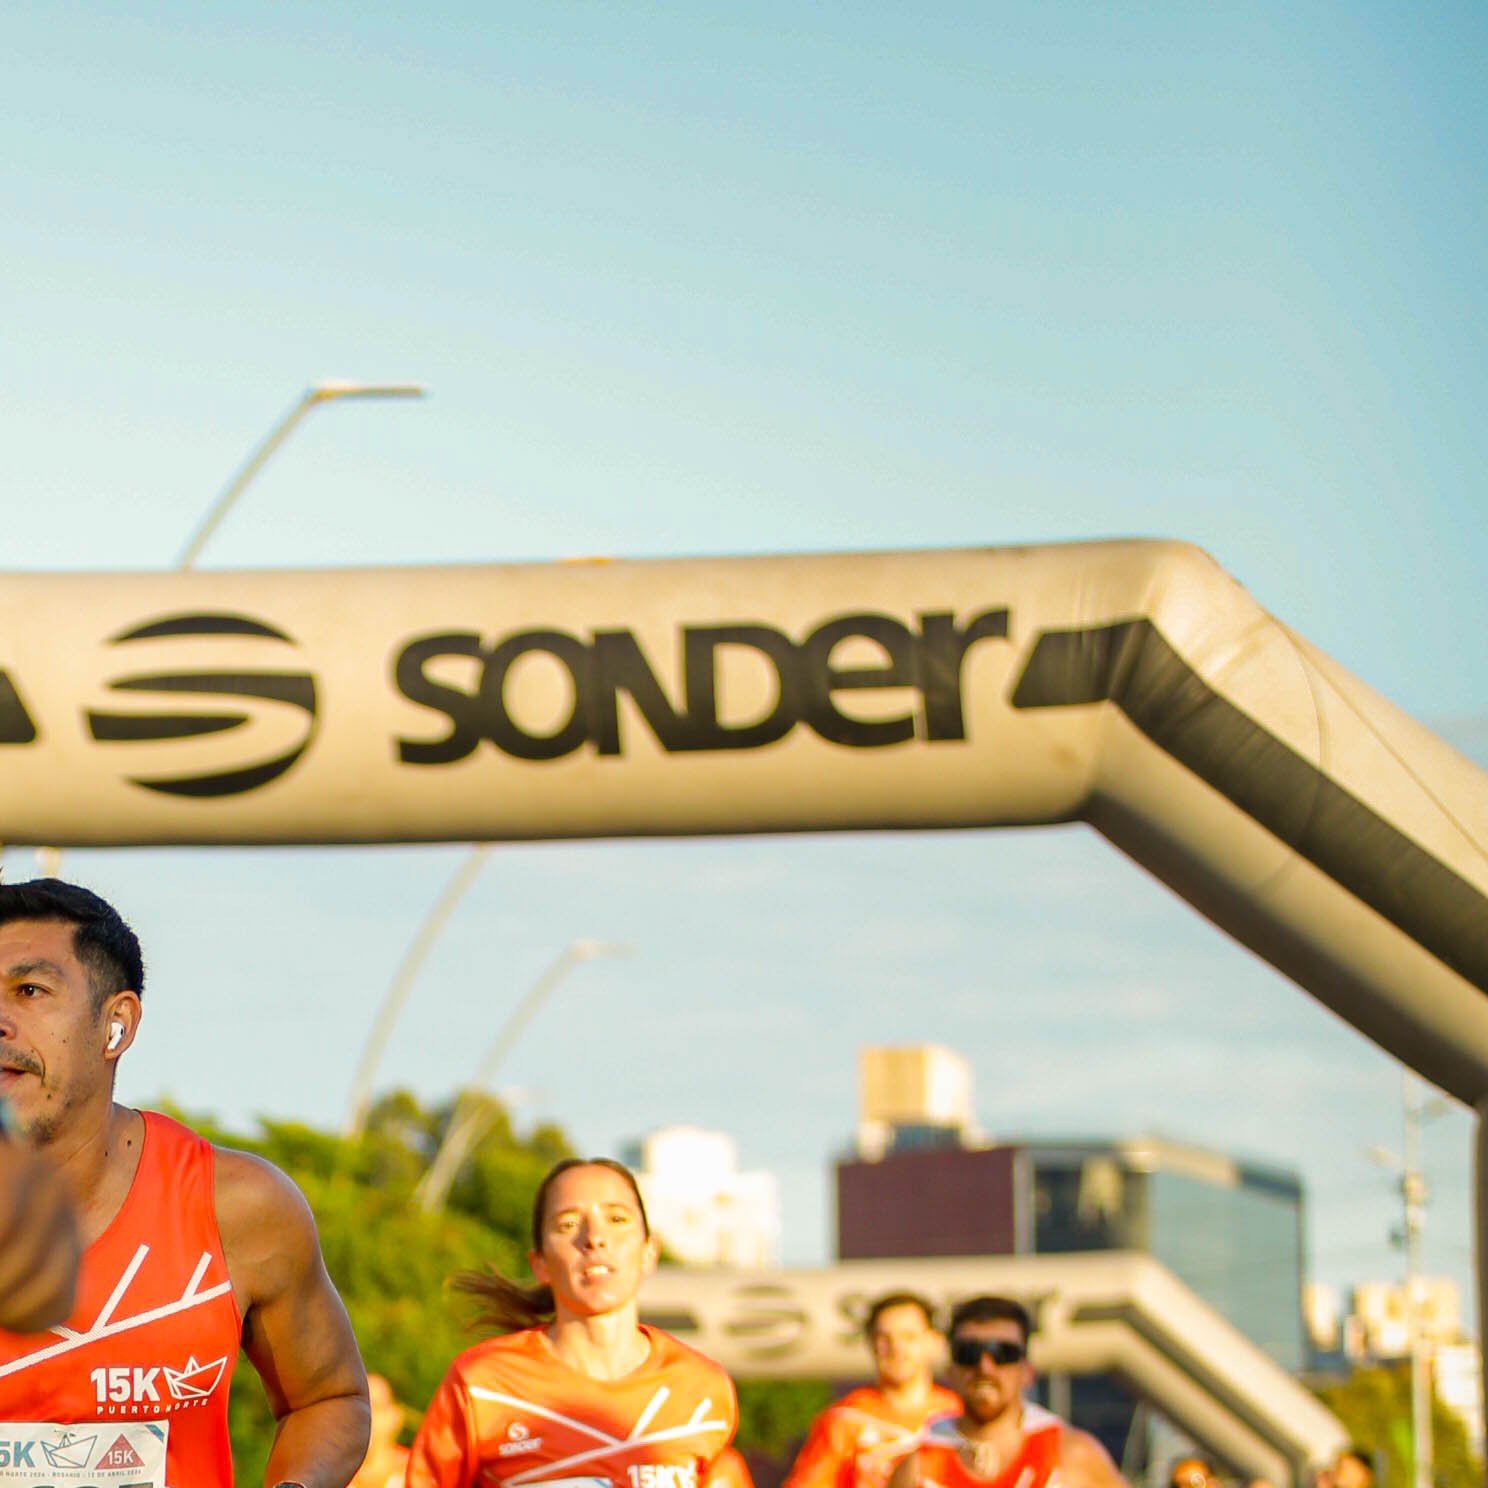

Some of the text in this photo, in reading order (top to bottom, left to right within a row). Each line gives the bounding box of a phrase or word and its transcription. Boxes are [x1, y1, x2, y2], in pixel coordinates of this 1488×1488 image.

[90, 1367, 161, 1402] 15K
[96, 1398, 209, 1415] PUERTO NORTE
[107, 1450, 134, 1465] 15K
